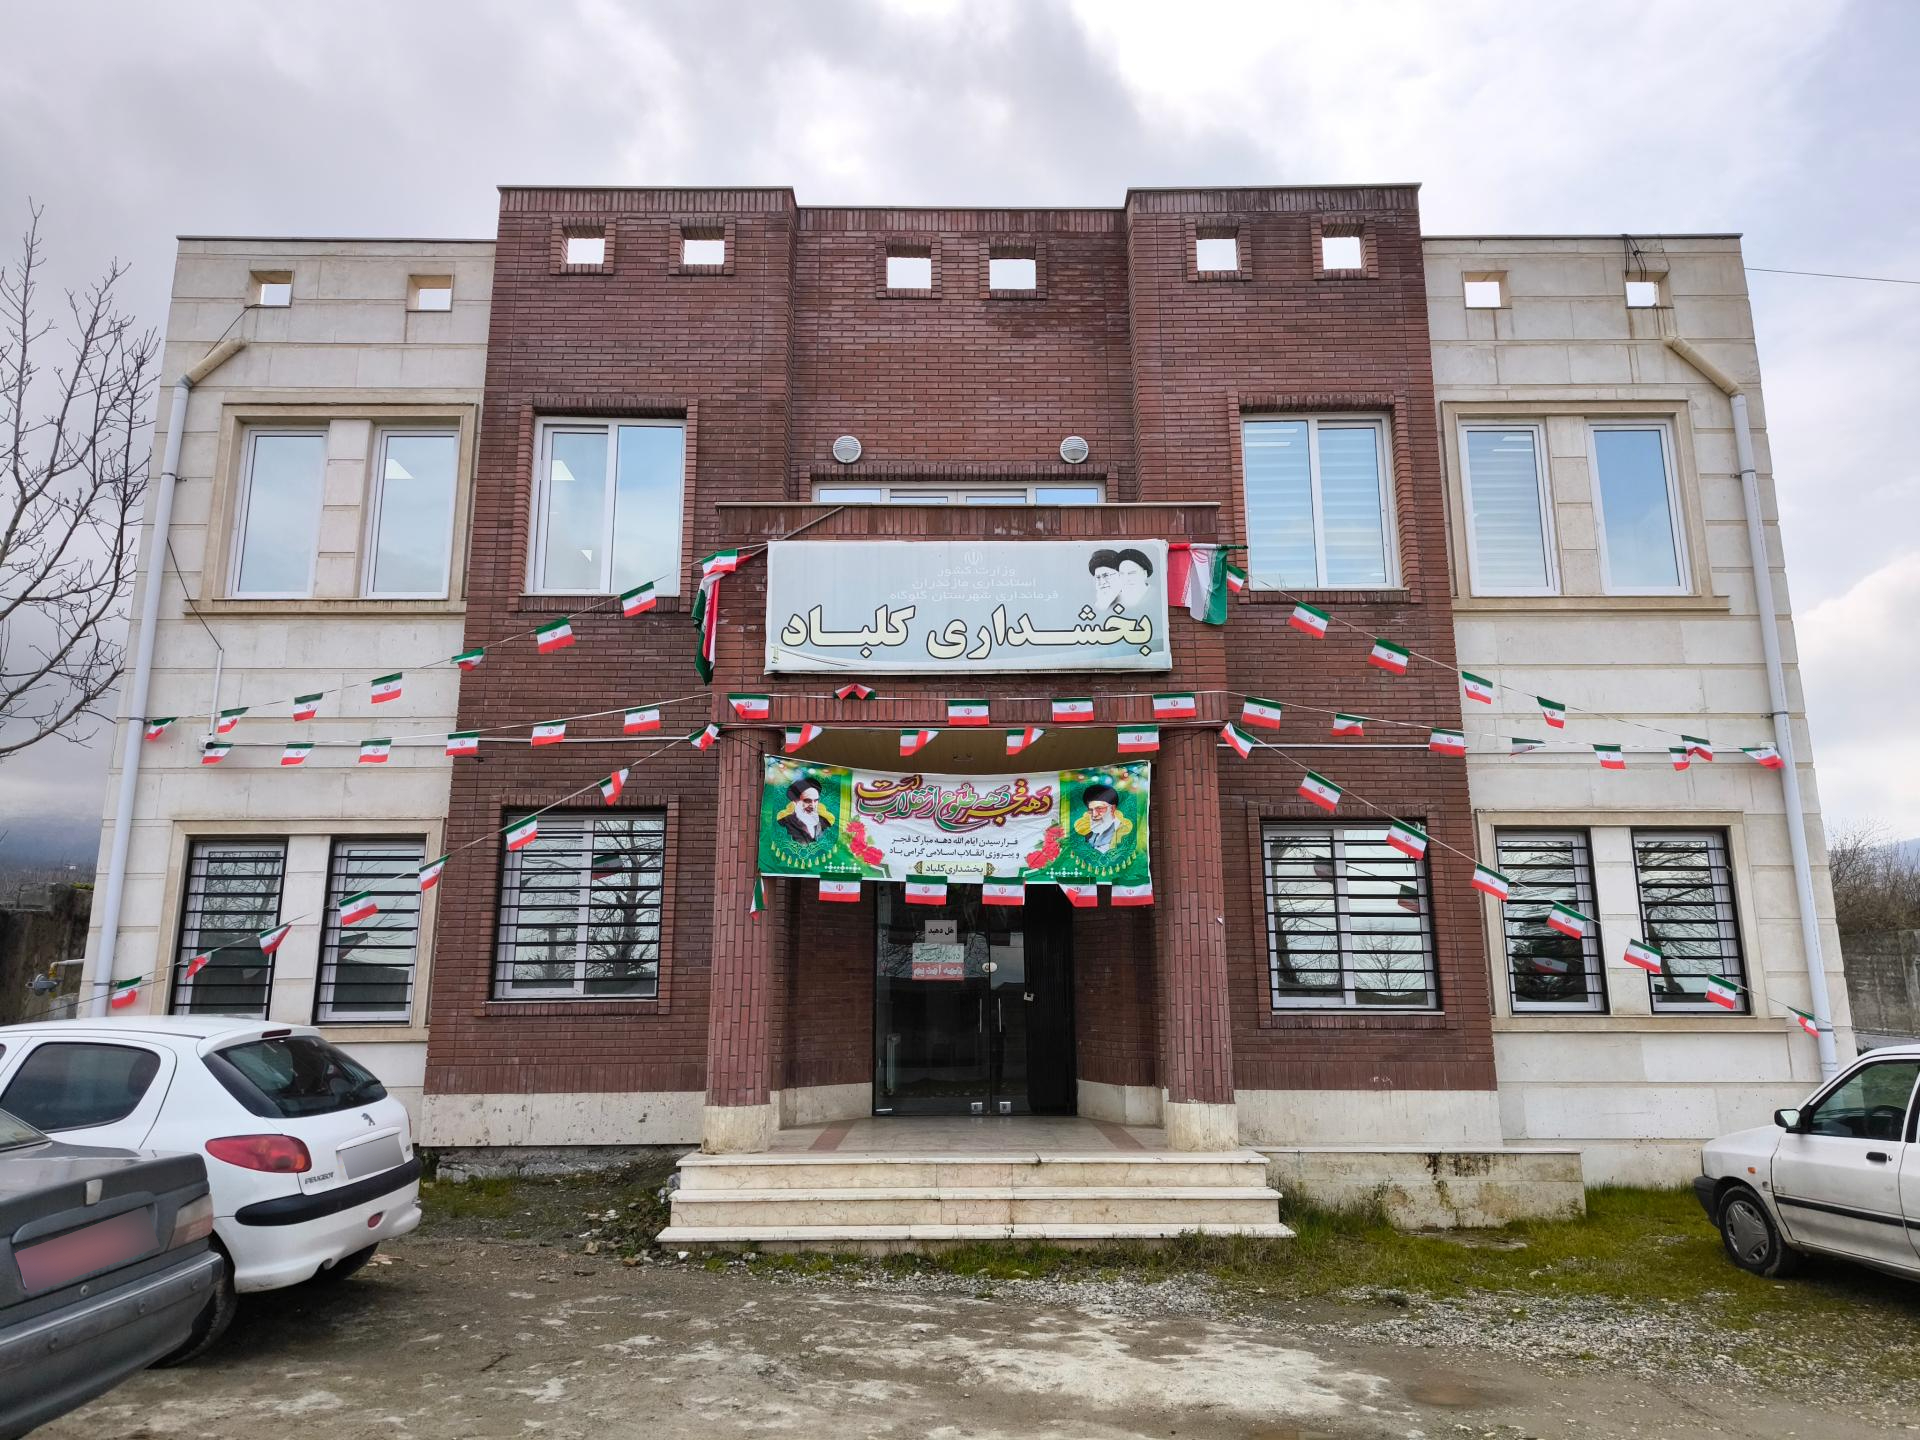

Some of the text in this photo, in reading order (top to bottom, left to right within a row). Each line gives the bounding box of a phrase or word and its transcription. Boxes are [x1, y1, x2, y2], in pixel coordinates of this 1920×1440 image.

[781, 603, 1153, 660] بخشداری کلباد
[912, 835, 933, 846] مبارک
[925, 863, 984, 875] بخشداری کلباد
